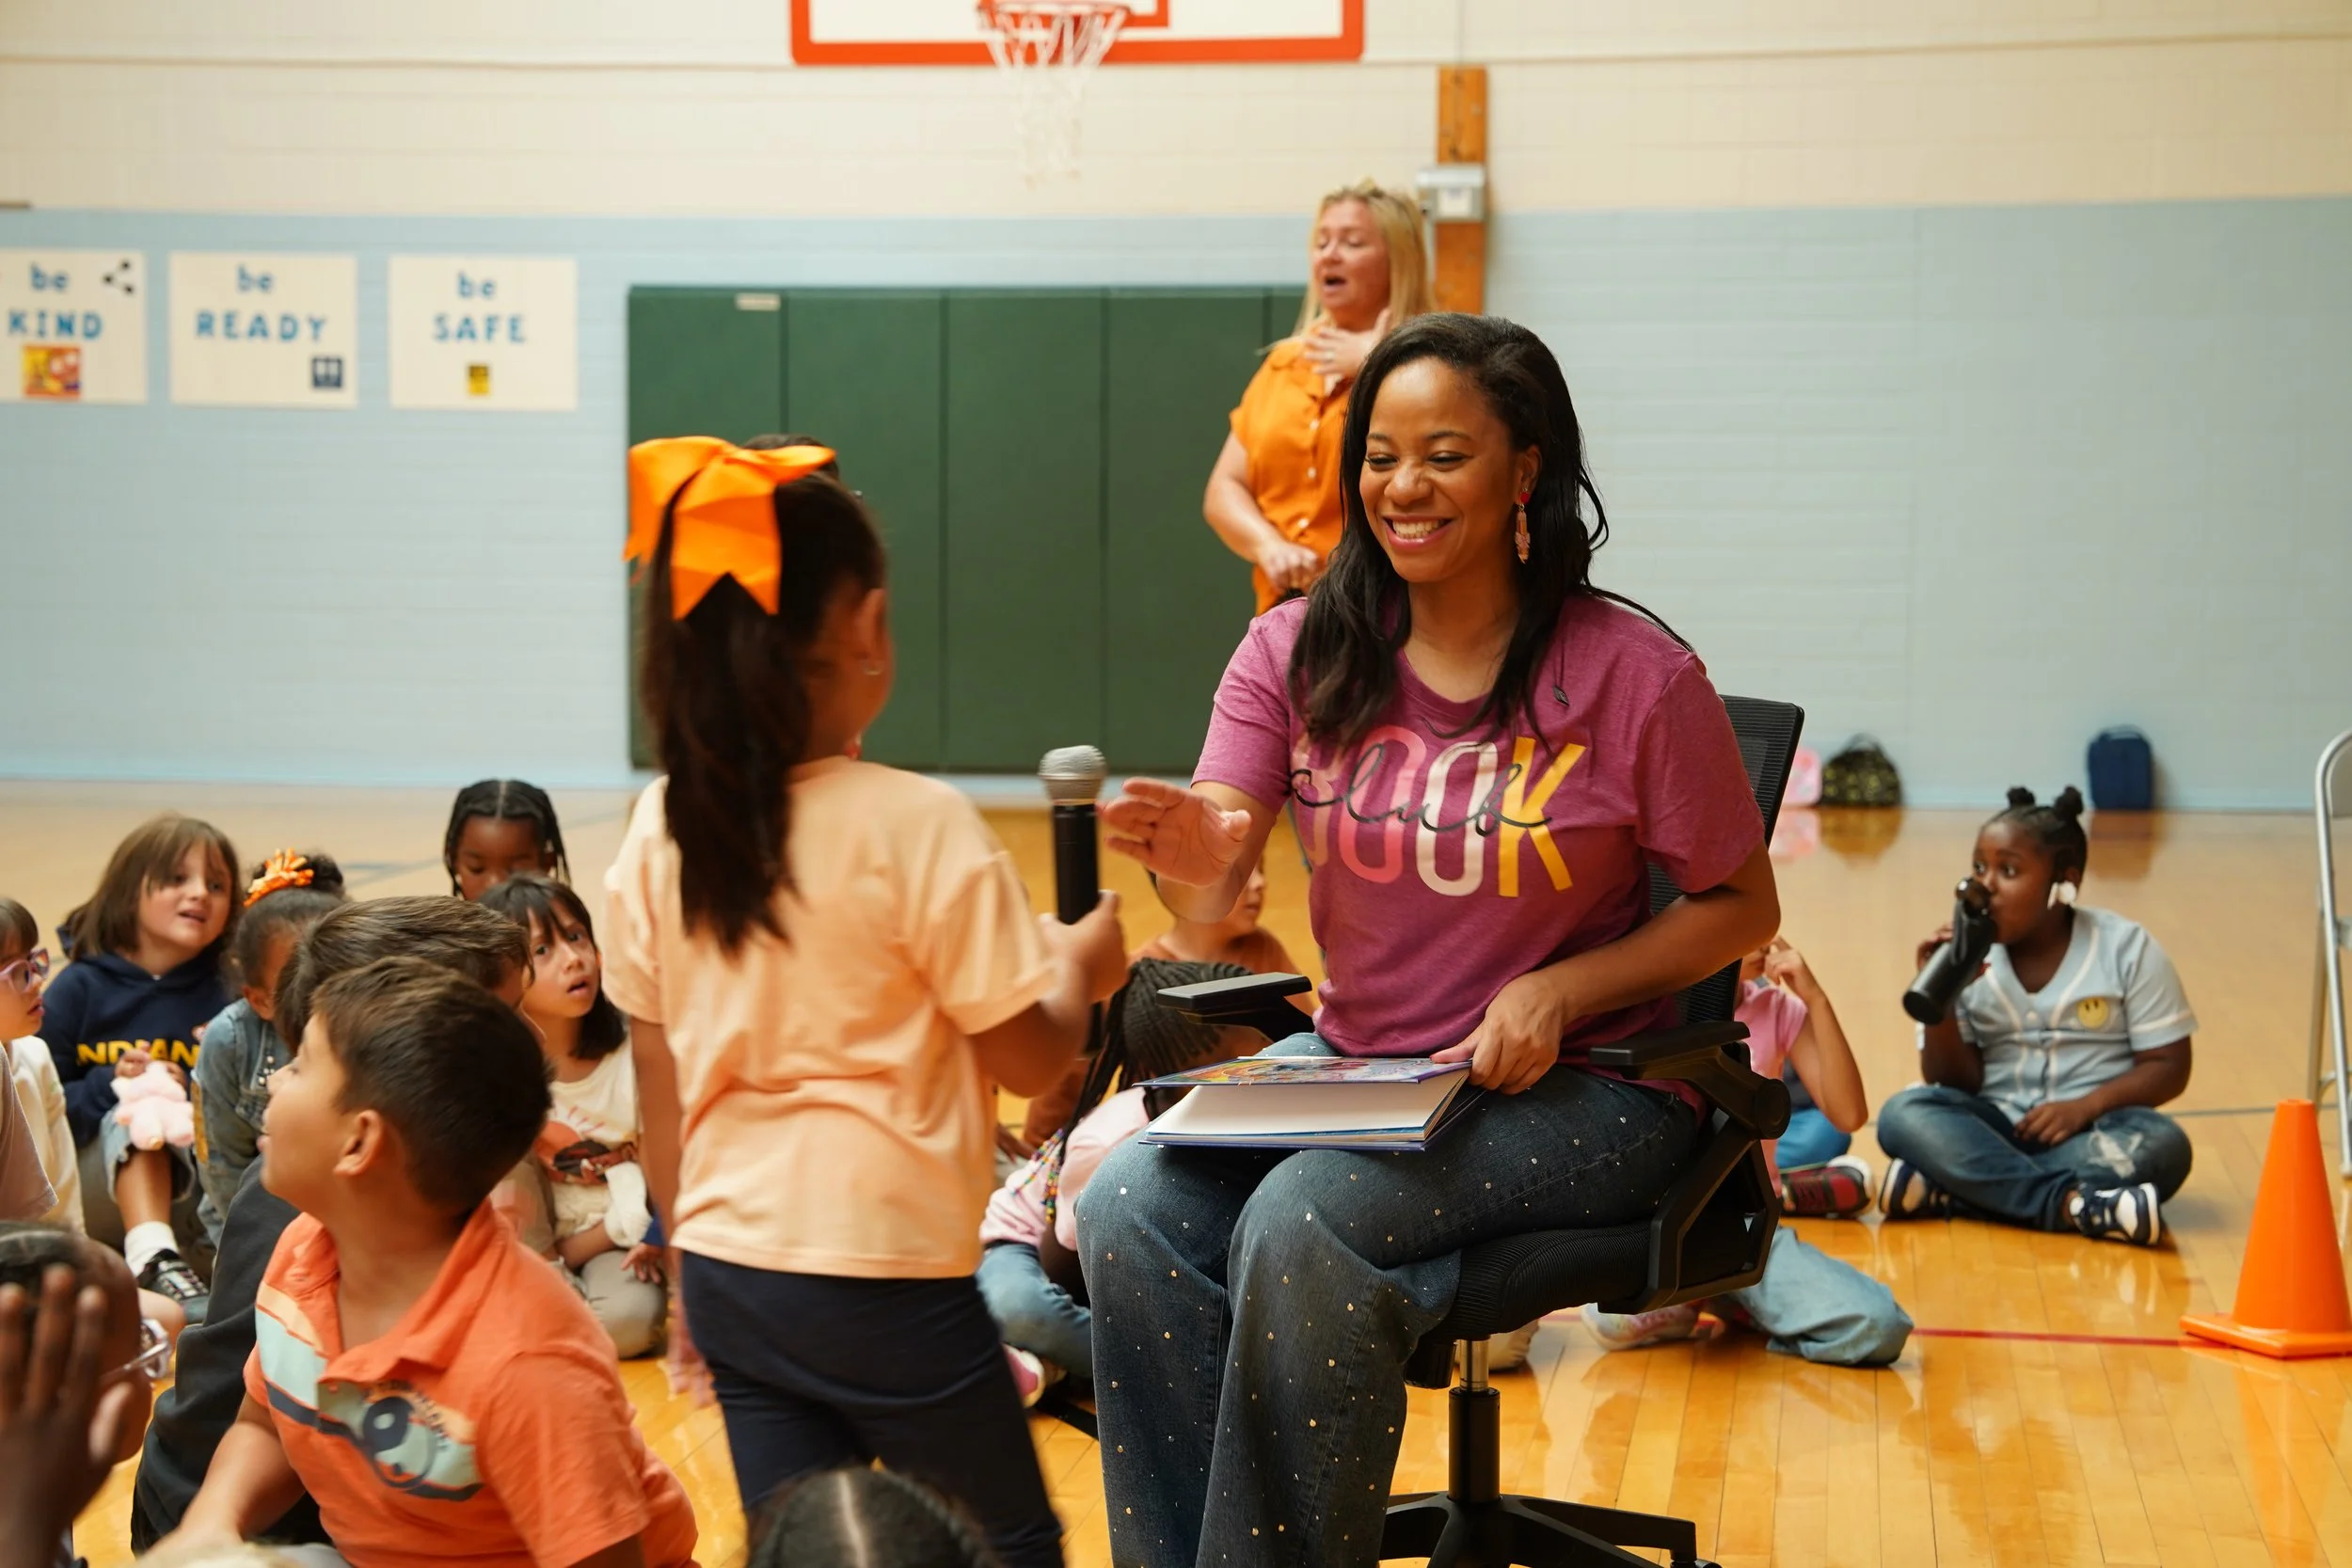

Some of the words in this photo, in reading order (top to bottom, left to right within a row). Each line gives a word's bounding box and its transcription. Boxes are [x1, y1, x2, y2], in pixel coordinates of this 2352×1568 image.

[30, 263, 69, 293] be
[237, 264, 273, 293] be
[458, 273, 496, 300] be
[8, 310, 103, 341] KIND
[196, 309, 326, 342] READY
[434, 313, 526, 343] SAFE
